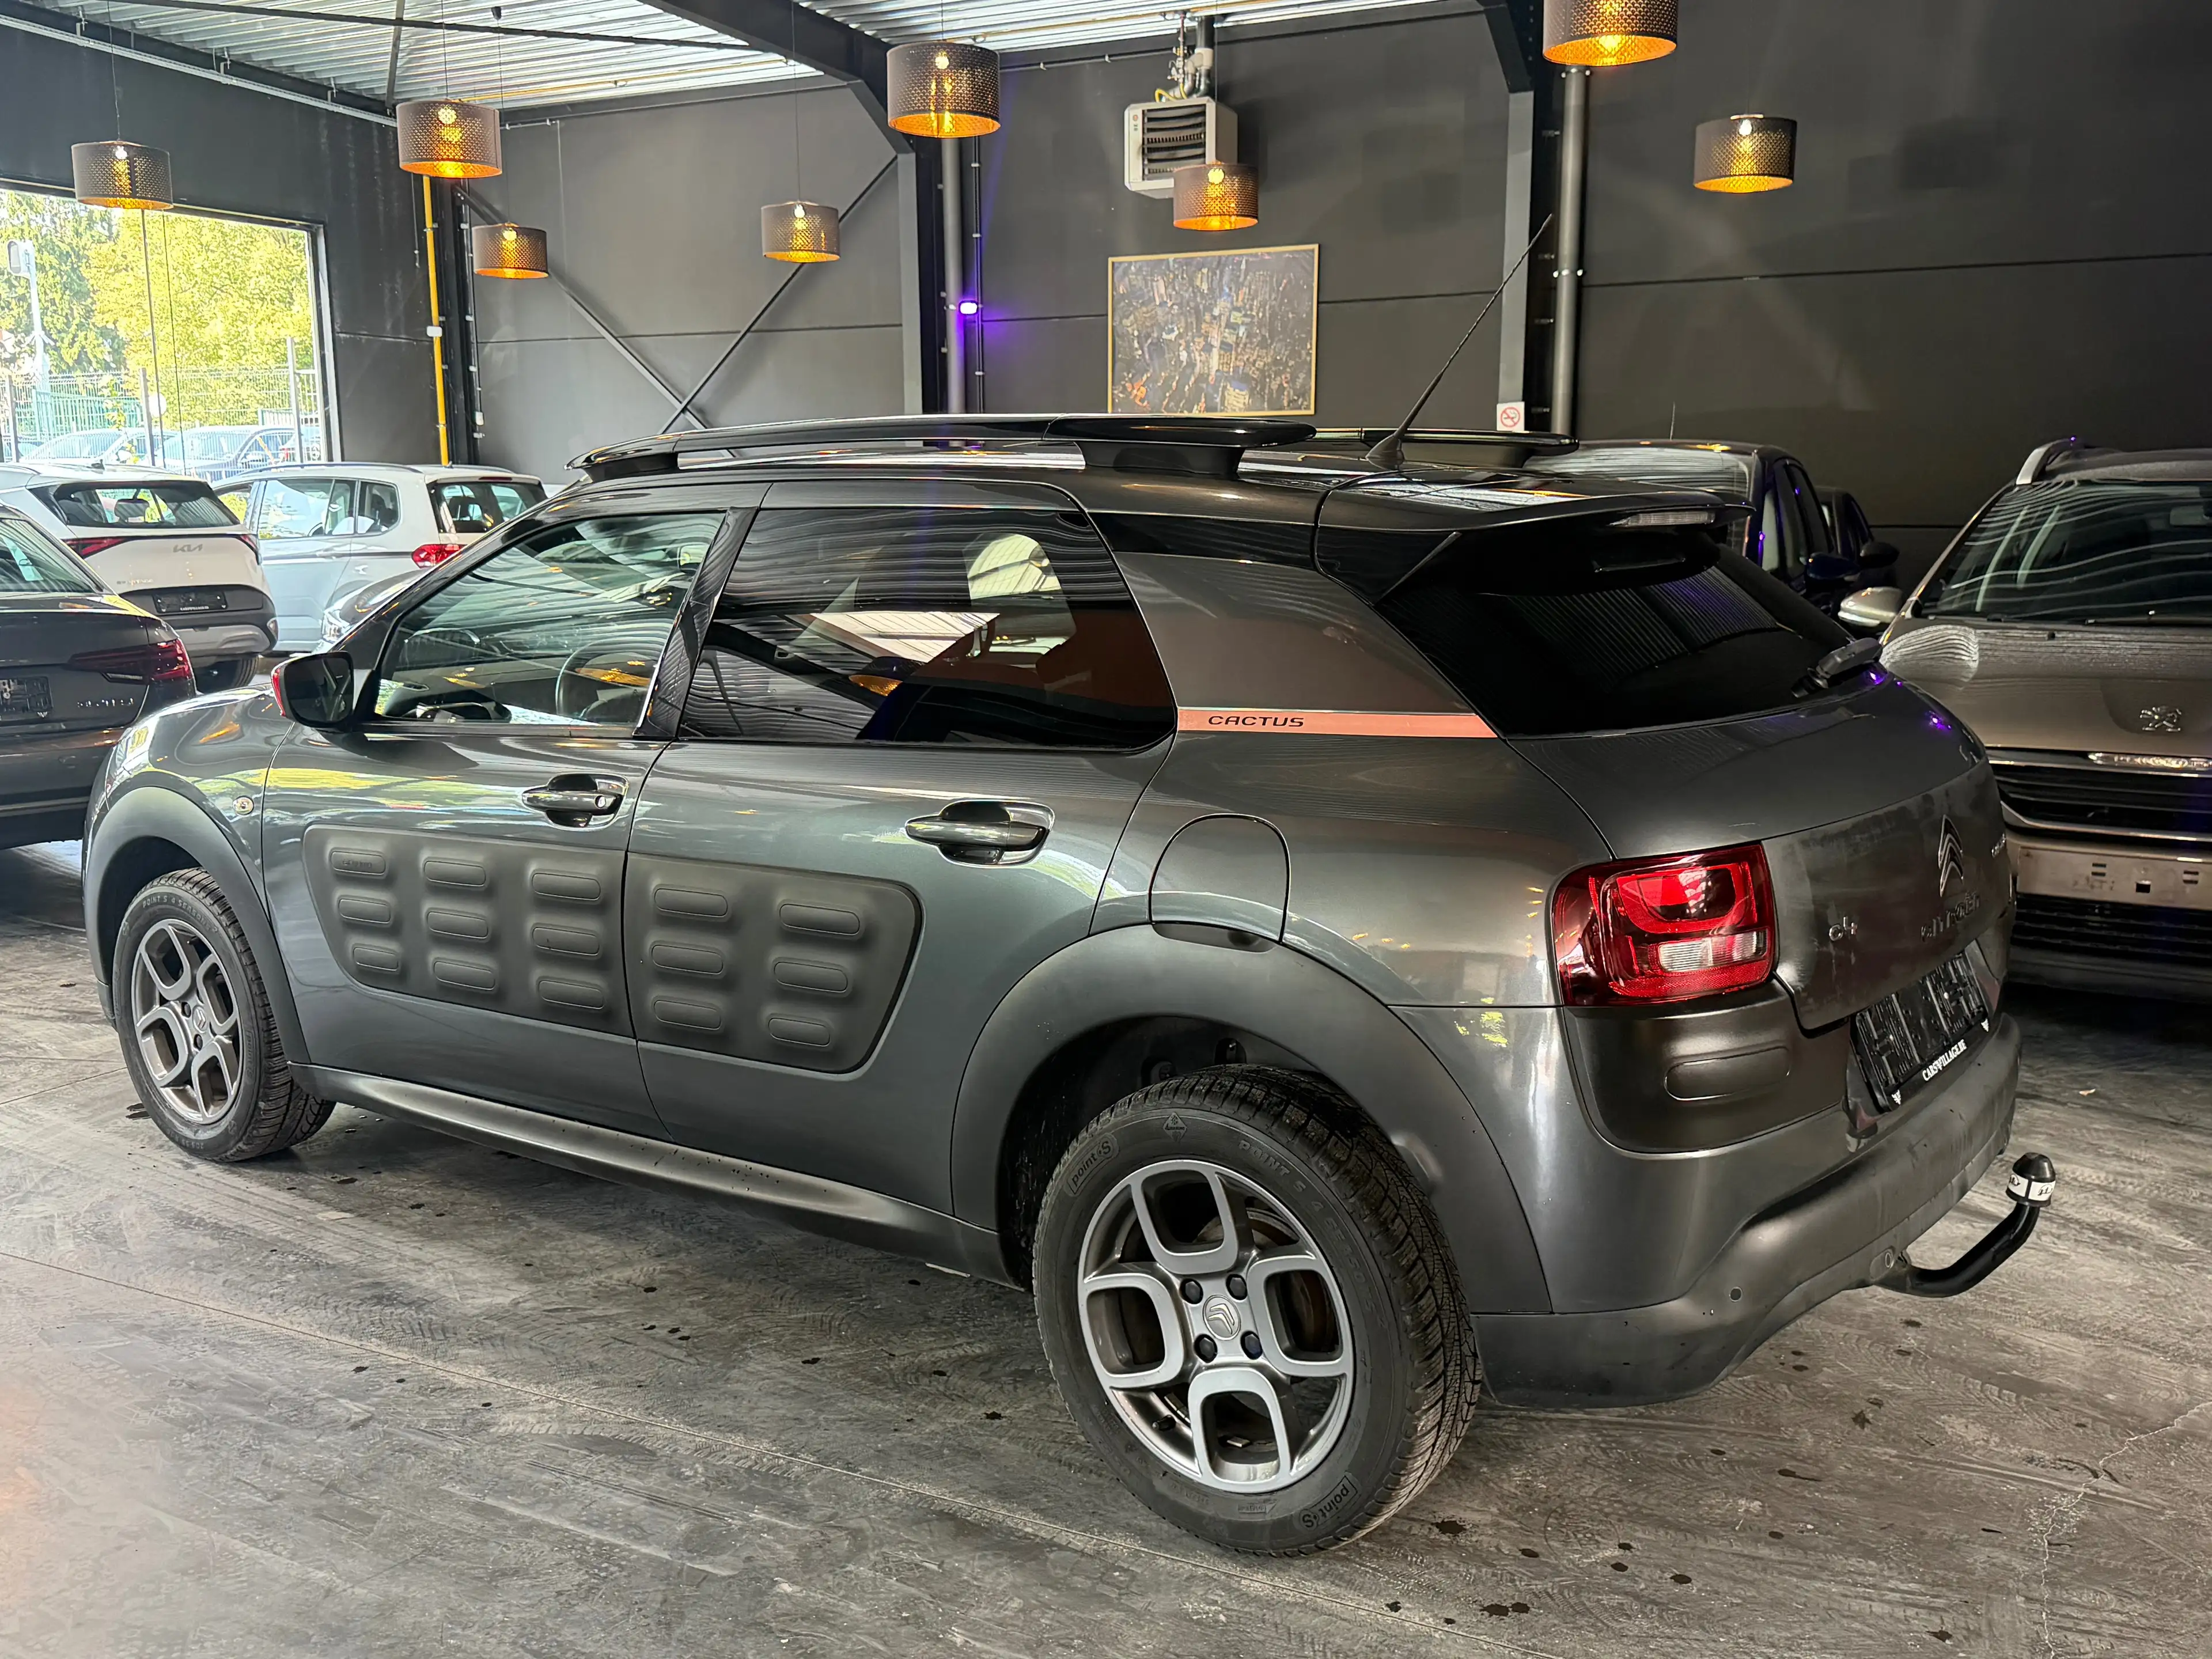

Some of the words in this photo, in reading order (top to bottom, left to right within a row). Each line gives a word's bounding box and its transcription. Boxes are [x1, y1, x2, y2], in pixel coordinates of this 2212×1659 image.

[1207, 715, 1305, 728] CACTUS
[142, 895, 161, 908] POINT
[1238, 1139, 1291, 1177] POINT
[1293, 1181, 1306, 1192] S
[1310, 1200, 1324, 1211] 4
